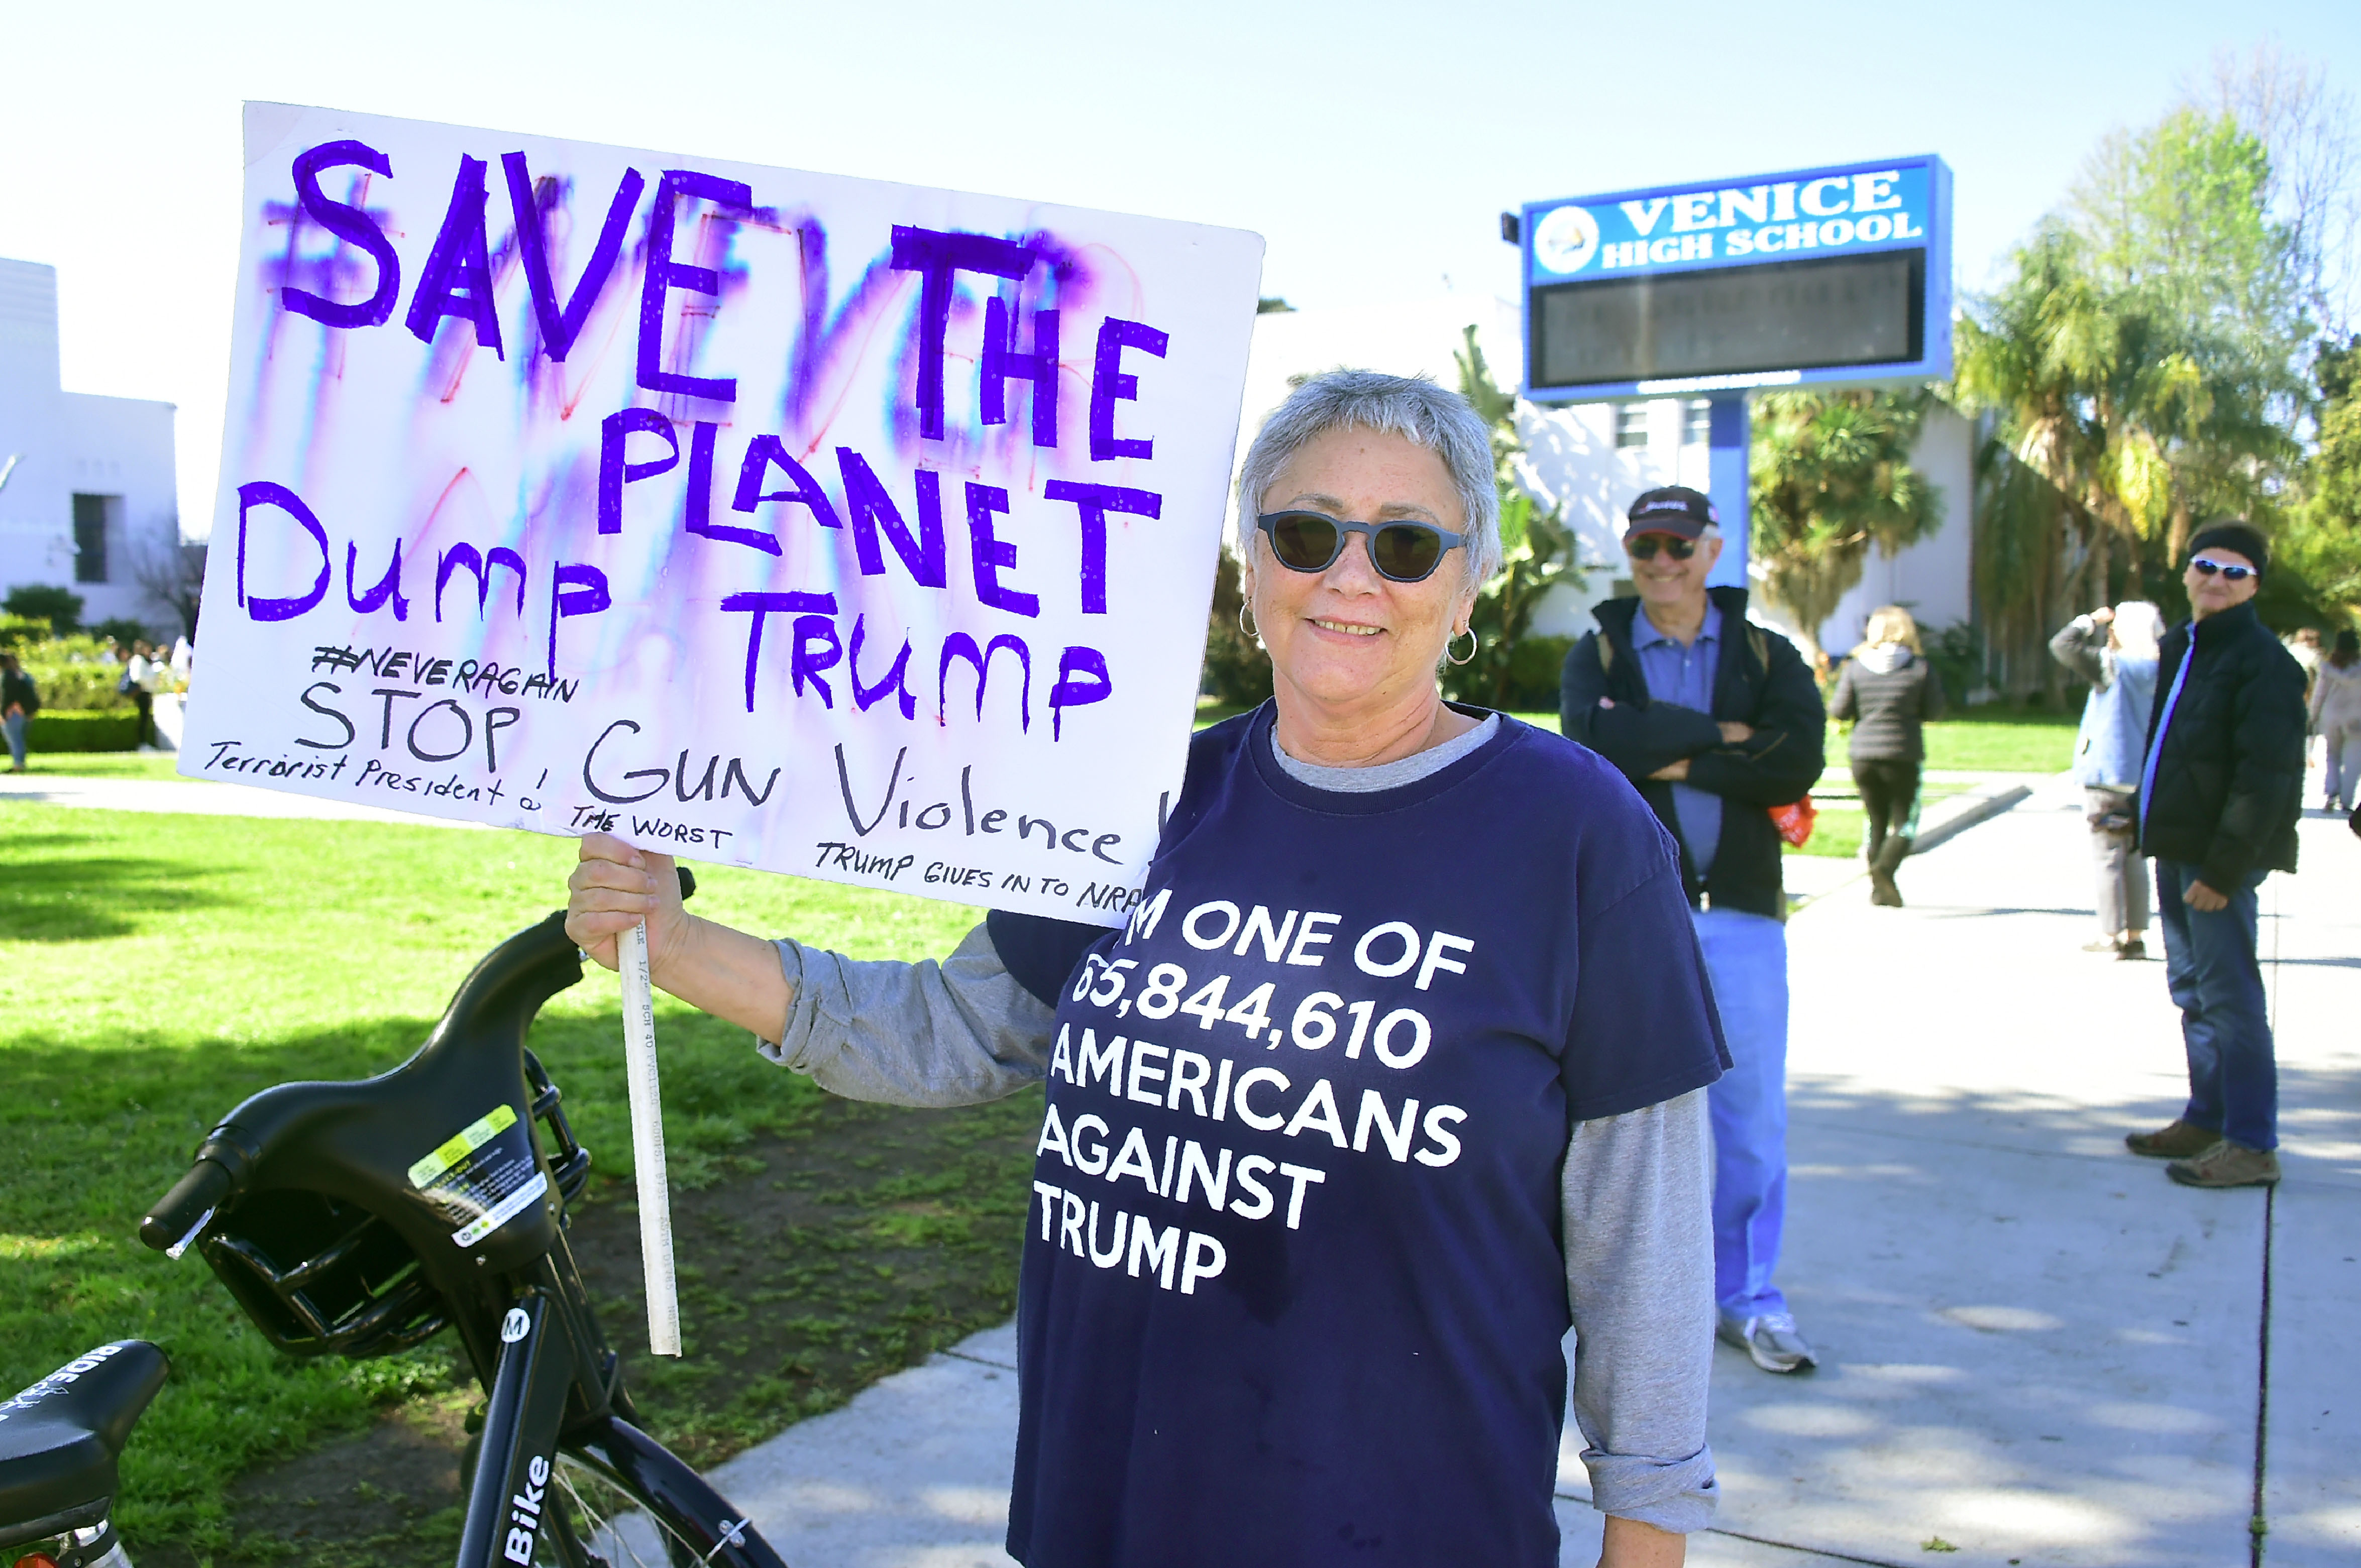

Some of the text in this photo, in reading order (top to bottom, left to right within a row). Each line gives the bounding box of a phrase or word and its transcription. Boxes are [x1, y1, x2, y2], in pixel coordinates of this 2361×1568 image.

[1601, 212, 1922, 270] HIGH SCHOOL
[1620, 170, 1902, 236] VENICE
[281, 140, 753, 403] SAVE
[891, 224, 1169, 461] THE
[598, 407, 1162, 618] PLANET
[312, 645, 580, 703] #NEVERAGAIN
[294, 682, 520, 772] STOP
[834, 742, 1124, 865] Violence
[356, 759, 505, 806] President
[632, 815, 733, 849] WORST
[816, 842, 914, 881] TRUMP
[1001, 873, 1031, 893] IN
[1041, 878, 1069, 897] TO
[1076, 881, 1142, 914] NRA
[1182, 901, 1342, 966] ONE
[1354, 921, 1475, 991] OF
[1072, 953, 1432, 1069] 65,844,610
[1050, 1023, 1468, 1168] AMERICANS
[1036, 1103, 1326, 1230] AGAINST
[1033, 1180, 1227, 1295] TRUMP
[504, 1455, 549, 1567] Bike
